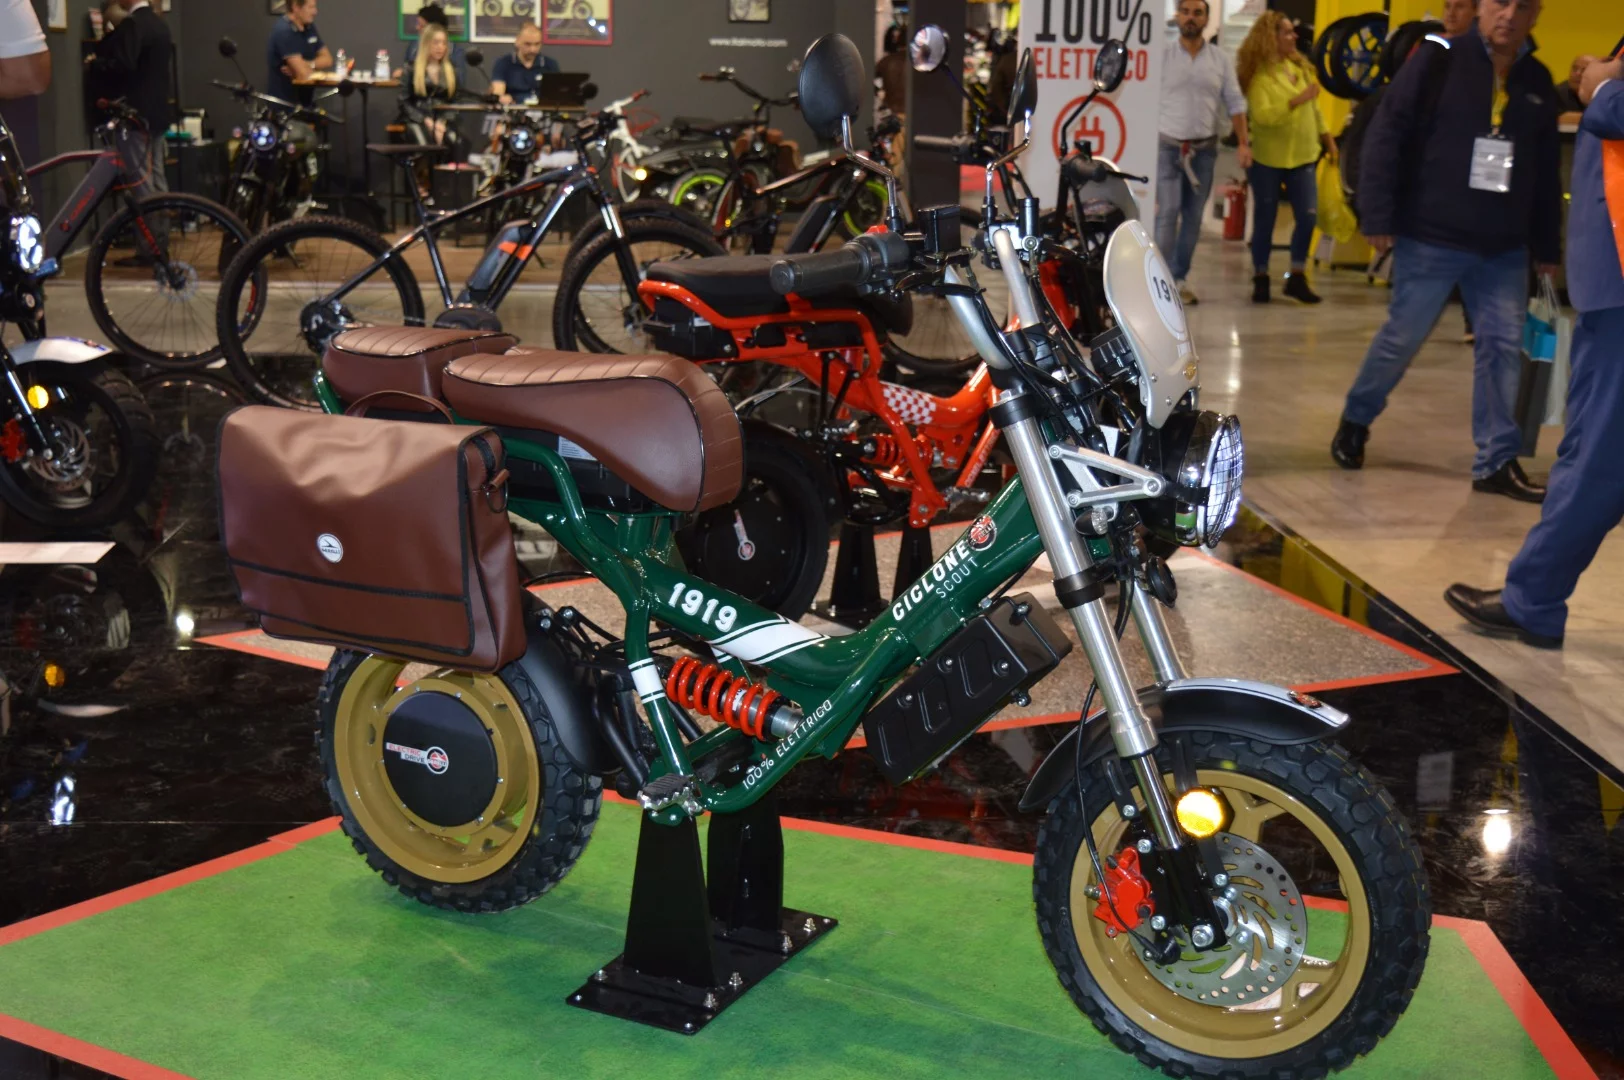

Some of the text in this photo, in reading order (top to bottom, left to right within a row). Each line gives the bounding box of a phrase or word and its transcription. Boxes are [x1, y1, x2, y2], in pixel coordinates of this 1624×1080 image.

[1035, 0, 1152, 45] 100%
[1033, 47, 1148, 82] ELETTCO
[892, 540, 970, 621] CICLONE
[935, 556, 978, 599] SCOUT
[668, 582, 738, 633] 1919
[388, 743, 421, 756] ELECTRIC
[404, 753, 425, 763] DRIVE
[742, 758, 775, 790] 100%
